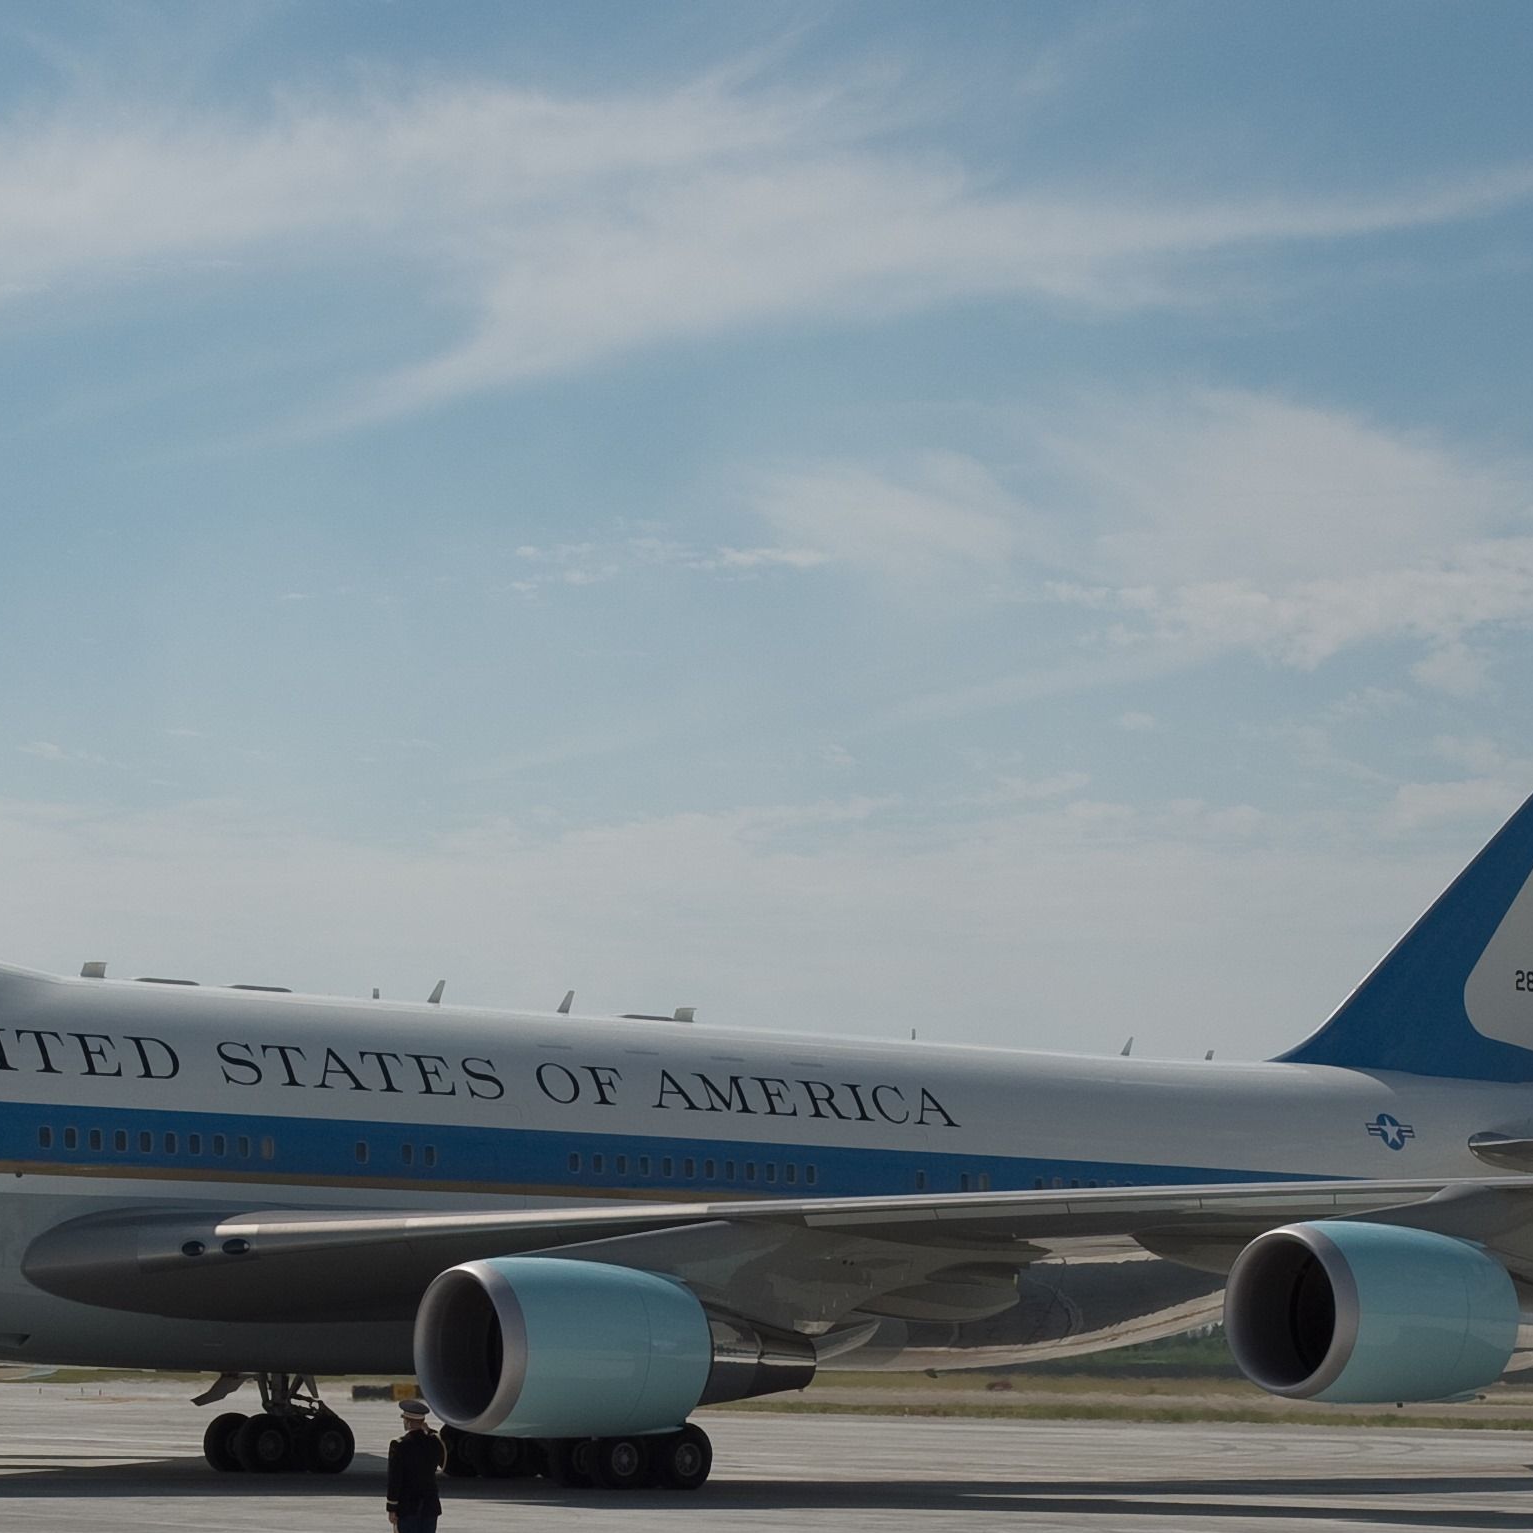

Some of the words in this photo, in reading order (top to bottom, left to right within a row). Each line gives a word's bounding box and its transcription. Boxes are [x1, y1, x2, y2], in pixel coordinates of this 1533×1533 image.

[215, 1041, 506, 1101] STATES
[534, 1062, 622, 1106] OF
[651, 1069, 962, 1129] AMERICA
